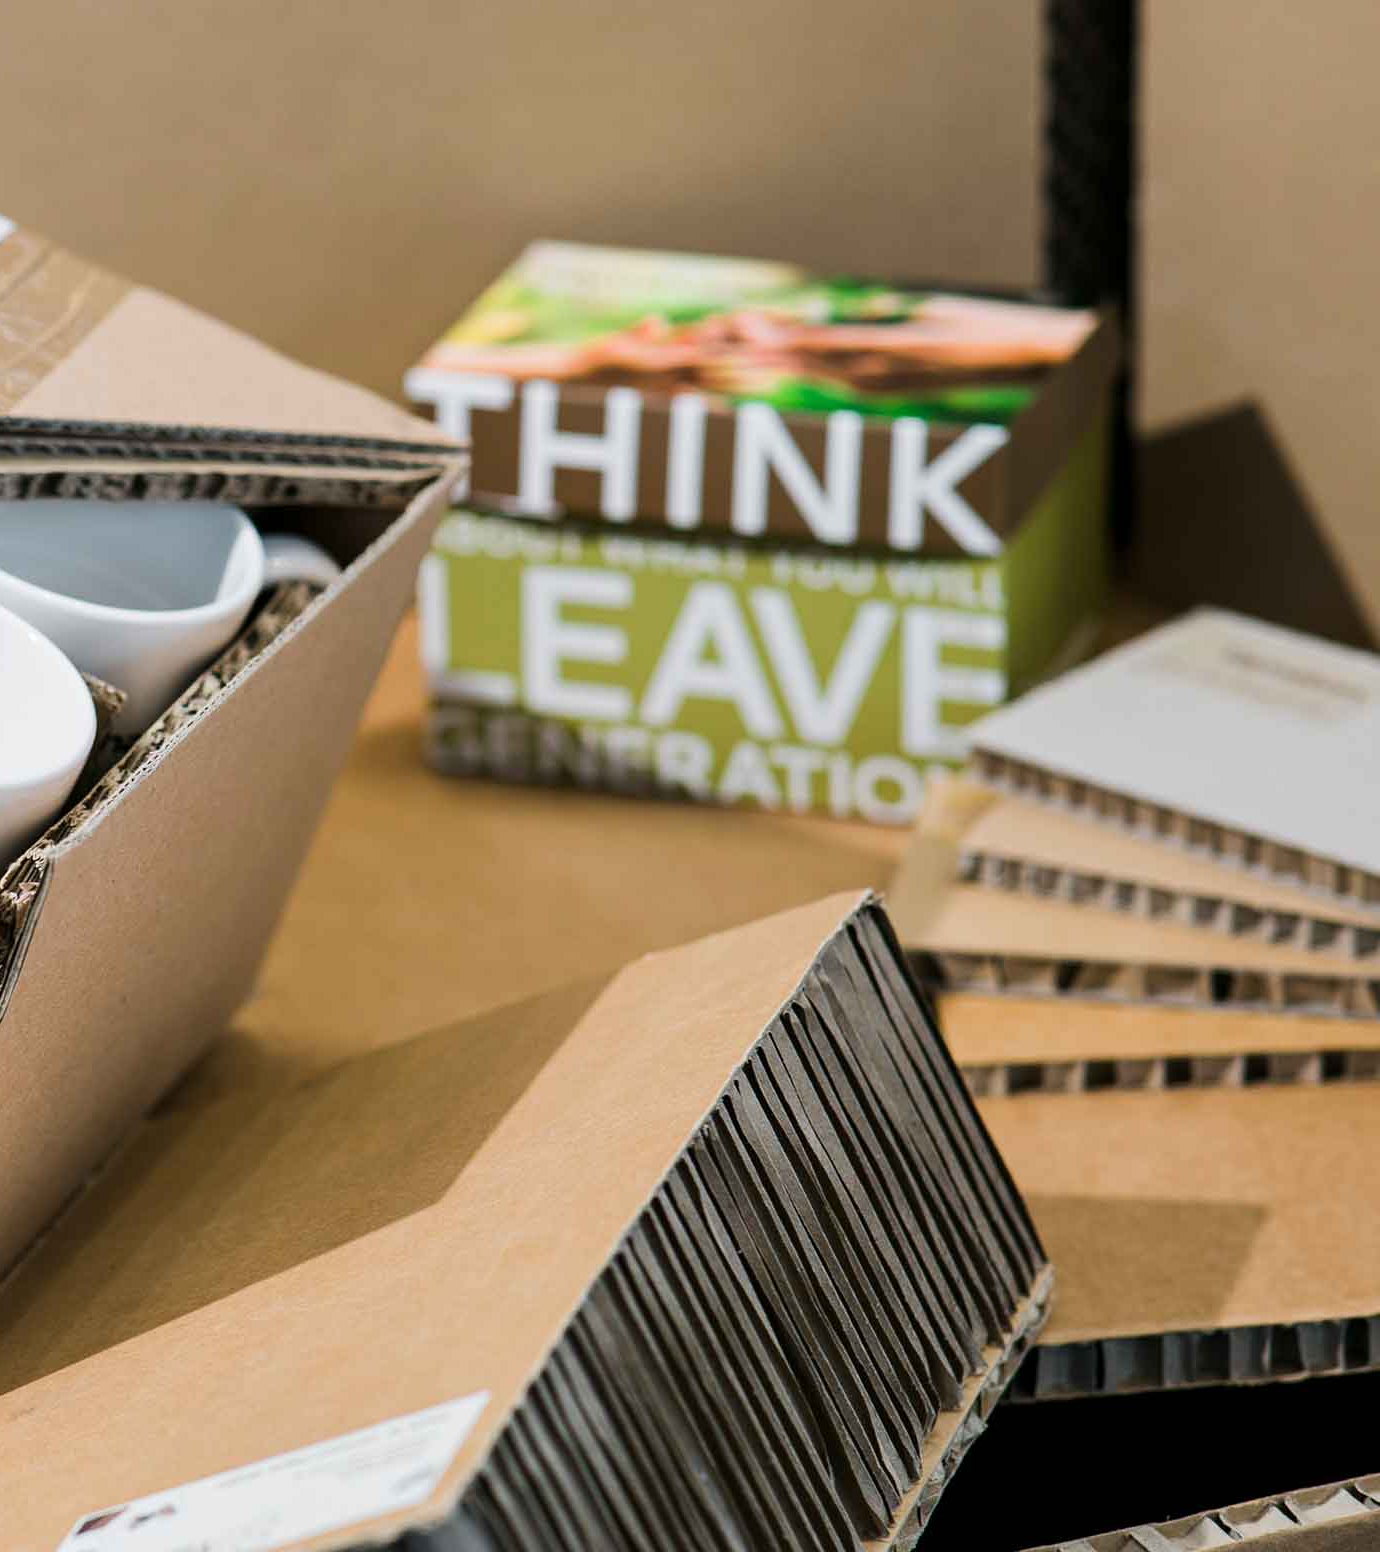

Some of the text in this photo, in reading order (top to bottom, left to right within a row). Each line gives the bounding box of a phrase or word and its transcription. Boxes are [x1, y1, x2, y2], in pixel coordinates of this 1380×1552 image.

[404, 368, 1010, 556] THINK
[420, 556, 1008, 758] LEAVE
[434, 704, 946, 826] GENERATIO
